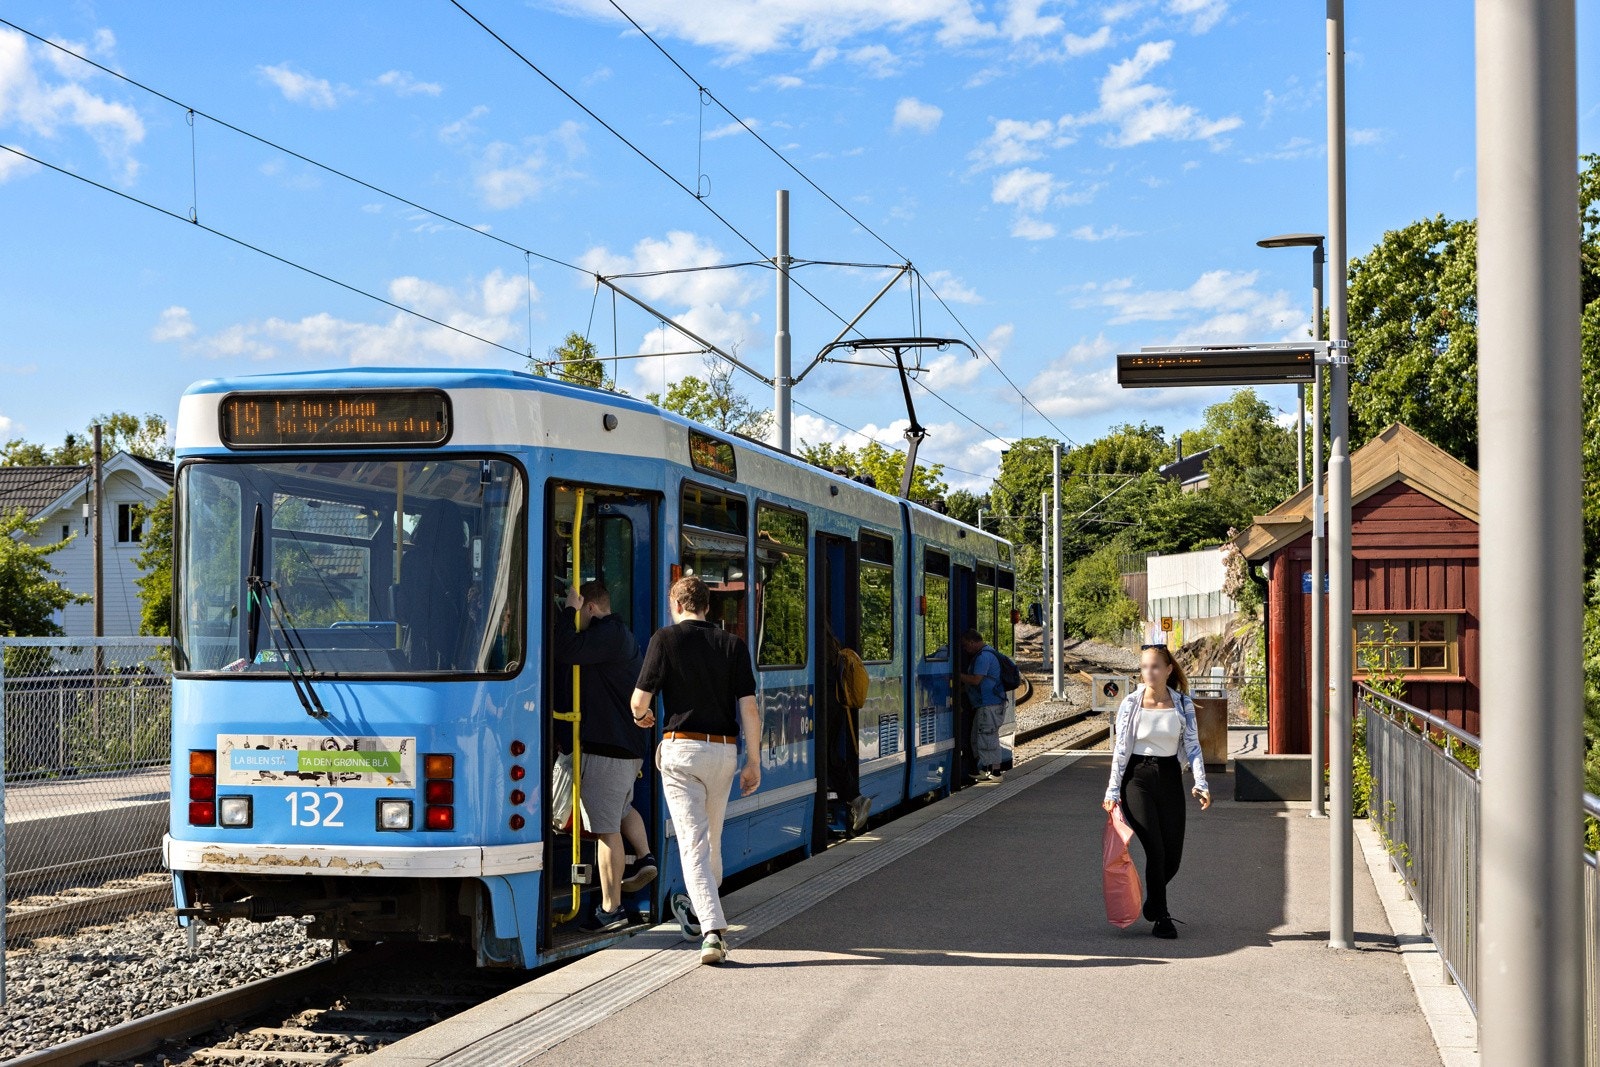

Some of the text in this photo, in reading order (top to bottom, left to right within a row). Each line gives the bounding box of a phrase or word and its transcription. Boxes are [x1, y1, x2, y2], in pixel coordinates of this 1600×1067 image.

[229, 401, 260, 436] 19
[1163, 619, 1171, 630] 5
[234, 754, 287, 765] LA BILEN STÅ
[301, 756, 389, 767] TA DEN GRØNNE BLÅ
[284, 791, 344, 828] 132
